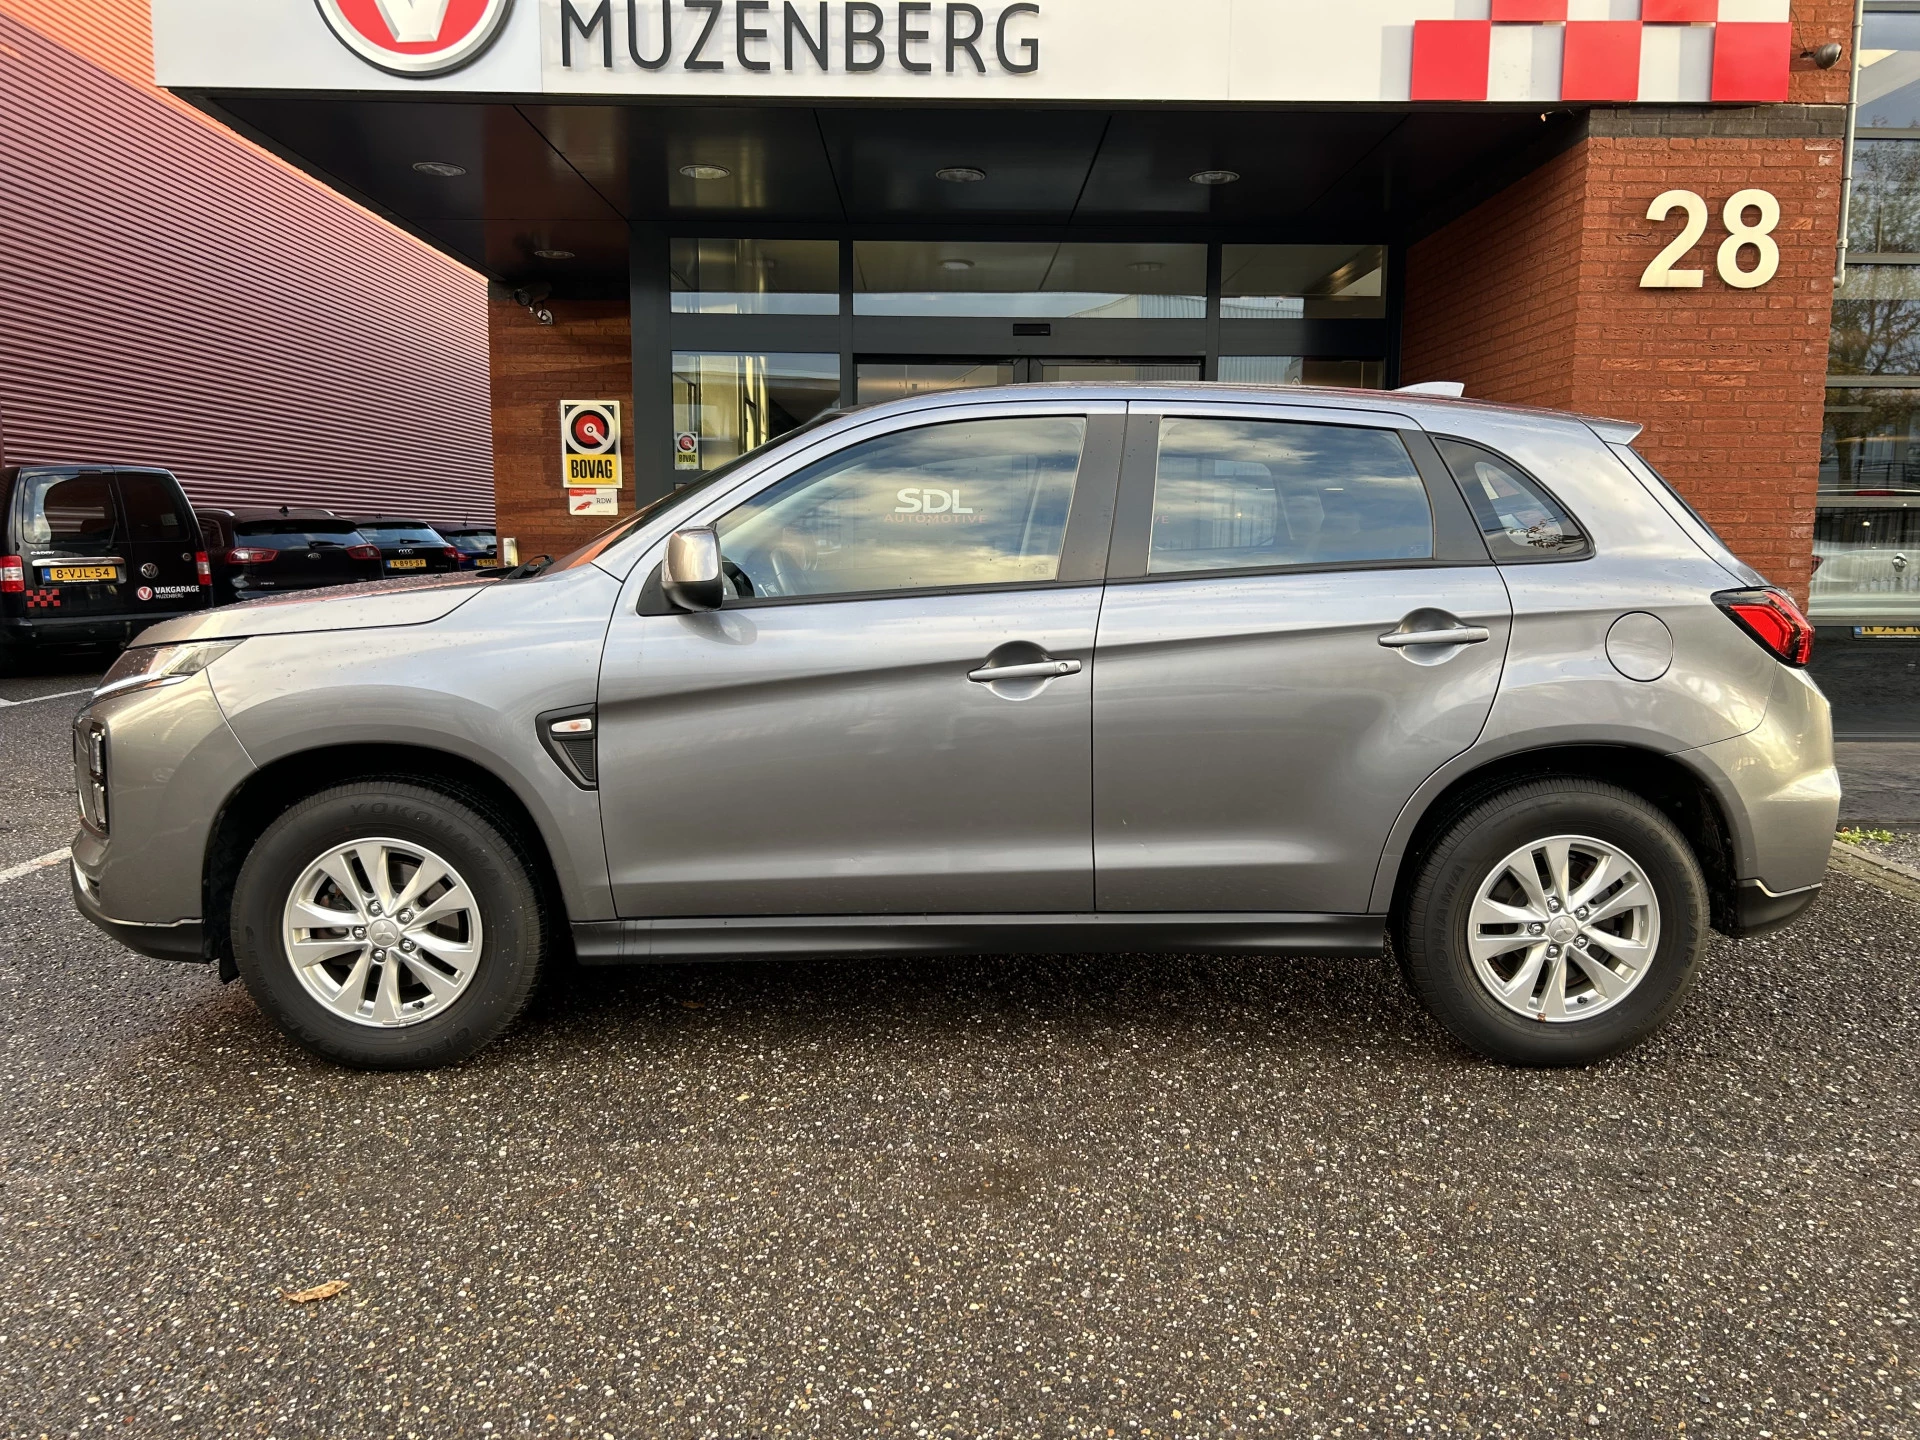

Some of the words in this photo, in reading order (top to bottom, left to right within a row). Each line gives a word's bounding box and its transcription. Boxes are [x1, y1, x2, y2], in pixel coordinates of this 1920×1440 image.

[560, 0, 1040, 73] MUZENBERG
[1639, 189, 1780, 289] 28
[678, 454, 696, 463] BOVAG
[571, 459, 613, 479] BOVAG
[894, 488, 974, 514] SDL
[883, 513, 989, 524] AUTOMOTIVE
[56, 567, 110, 579] 8-VJL-54
[154, 585, 200, 594] VAKGARAGE
